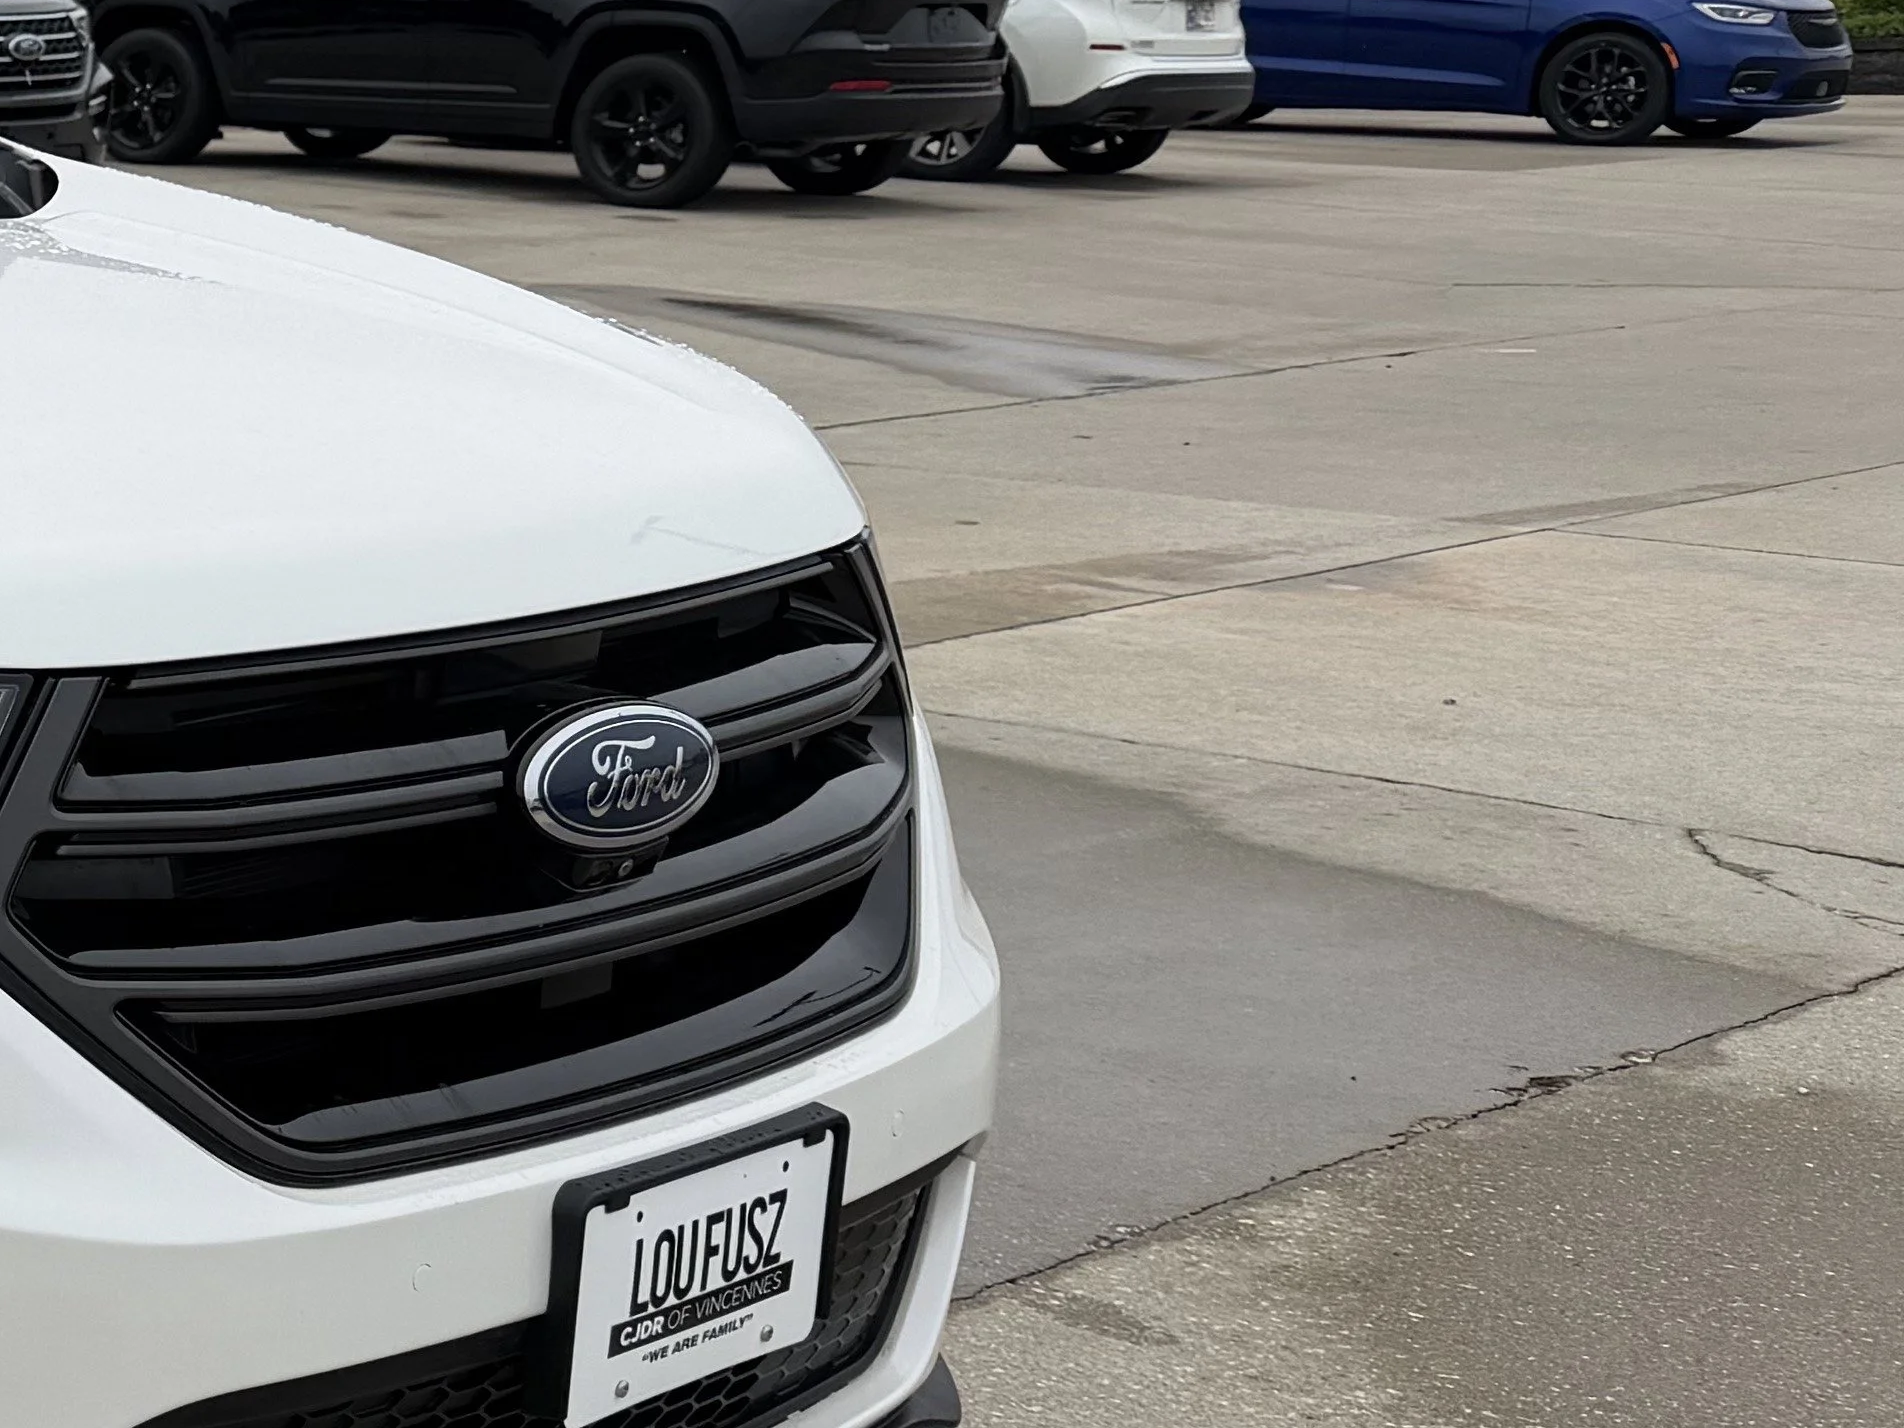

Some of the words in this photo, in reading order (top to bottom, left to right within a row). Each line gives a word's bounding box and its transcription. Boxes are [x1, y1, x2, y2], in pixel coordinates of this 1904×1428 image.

[586, 735, 686, 818] Ford
[628, 1218, 699, 1318] LOU
[699, 1188, 788, 1292] FUSZ
[619, 1315, 665, 1347] CJDR
[667, 1304, 692, 1329] OF
[694, 1270, 783, 1319] VINCENNES
[671, 1333, 698, 1354] ARE
